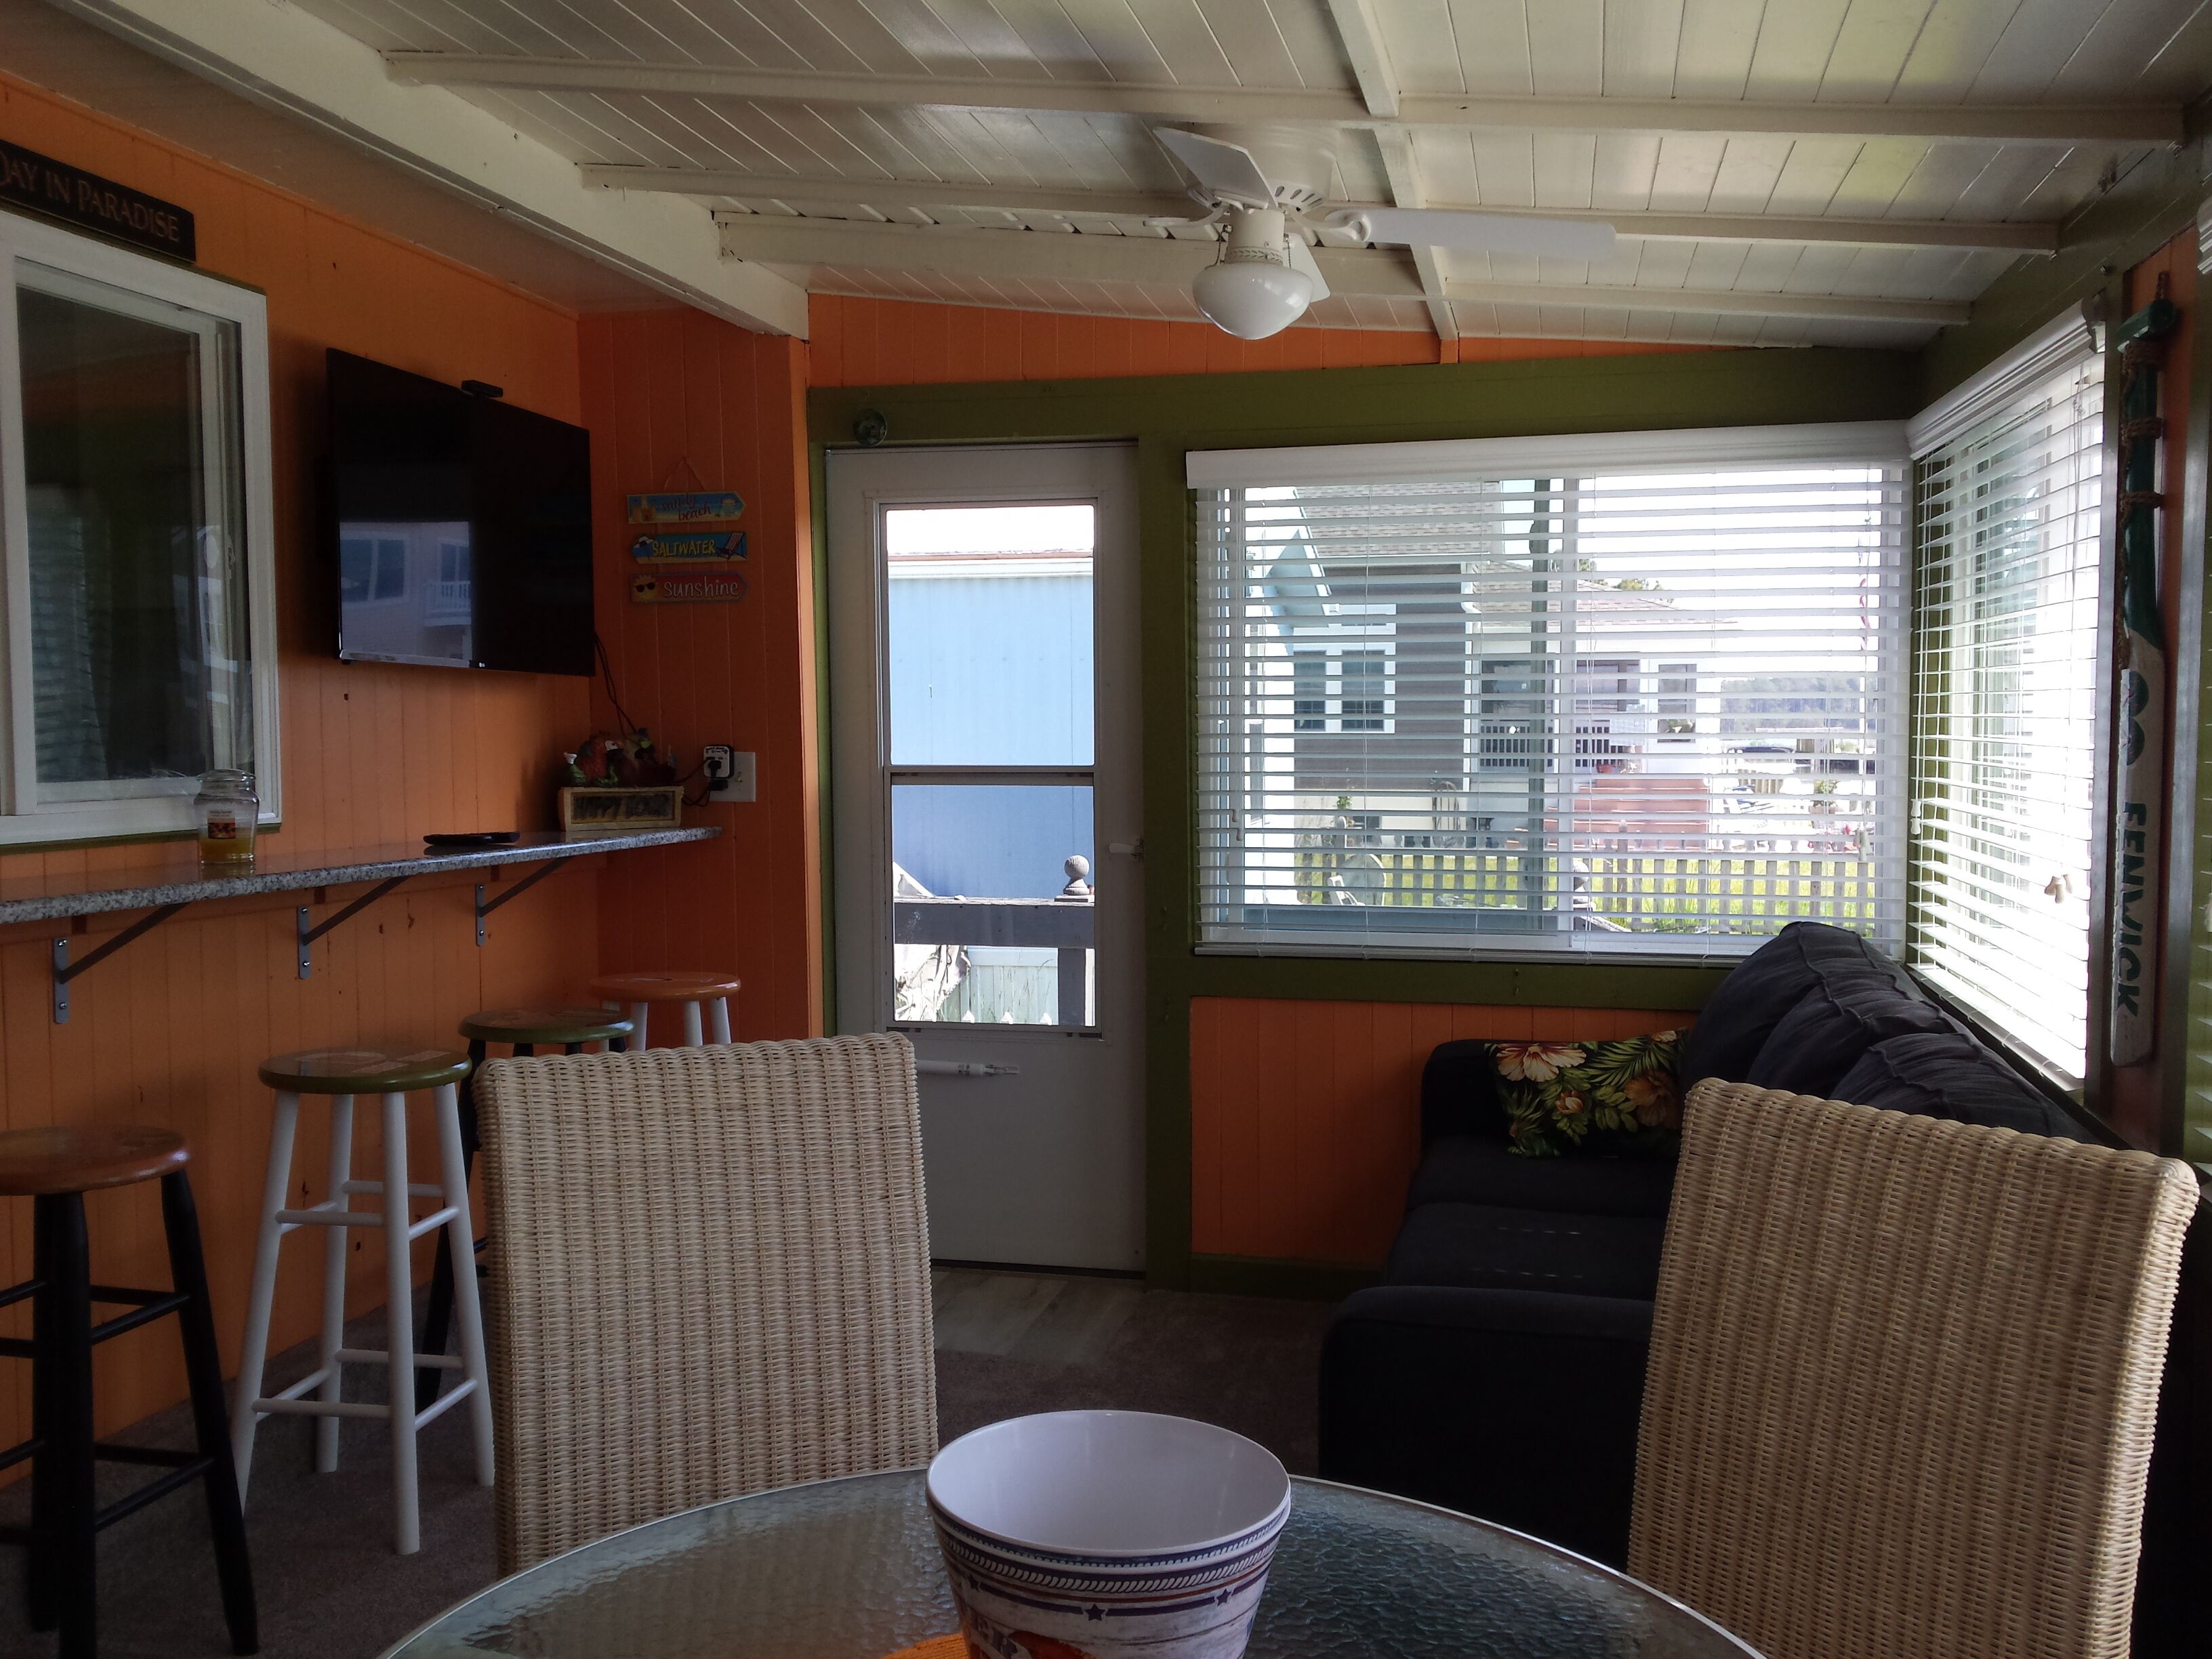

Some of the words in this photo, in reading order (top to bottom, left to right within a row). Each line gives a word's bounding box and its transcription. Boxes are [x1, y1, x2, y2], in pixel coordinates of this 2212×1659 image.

[45, 169, 71, 203] IN
[77, 179, 180, 243] PARADISE
[651, 539, 716, 557] SALTWATER
[662, 576, 739, 598] sunshine
[2113, 802, 2147, 1017] FENWICK
